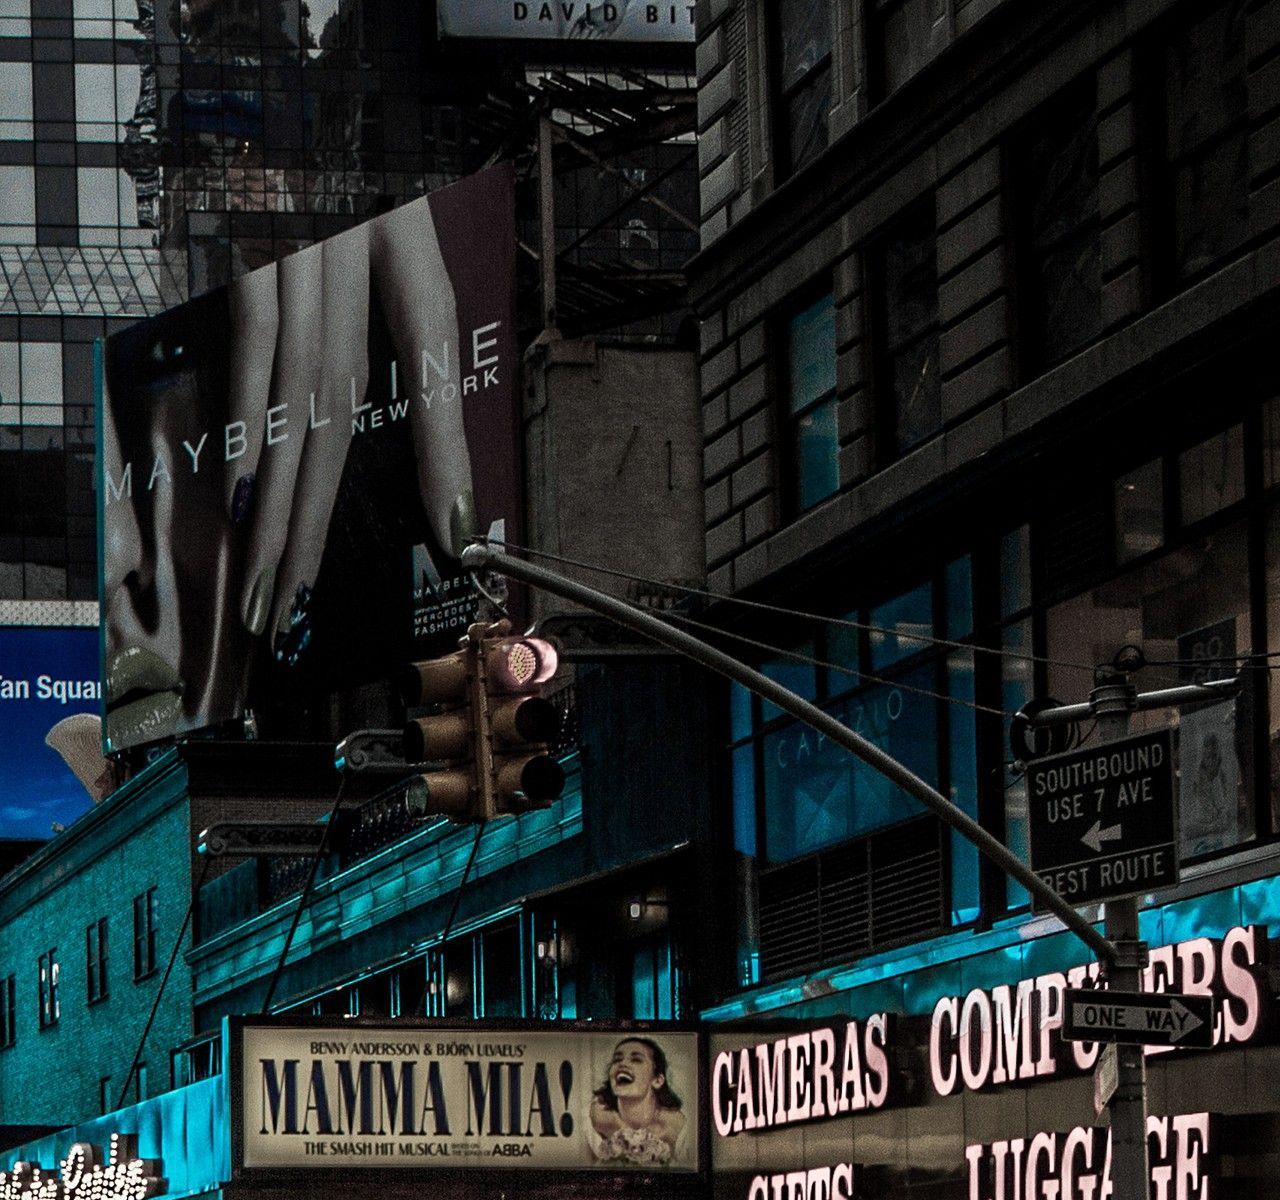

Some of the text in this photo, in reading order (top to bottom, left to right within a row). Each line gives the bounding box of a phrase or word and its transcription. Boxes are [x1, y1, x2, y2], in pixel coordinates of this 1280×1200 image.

[514, 2, 617, 22] DAVID
[105, 320, 501, 508] MAYBELLINE
[352, 366, 500, 436] NEW YORK
[1035, 743, 1163, 796] SOUTHBOUND
[1046, 777, 1154, 823] USE 7 AVE
[1099, 851, 1165, 888] ROUTE
[712, 925, 1261, 1138] CAMERAS COMPUERS
[1084, 1006, 1190, 1032] ONE WAY
[310, 1041, 347, 1055] BENNY
[351, 1042, 419, 1056] ANDERSSON
[424, 1043, 433, 1056] &
[436, 1040, 474, 1056] BJÖRN
[259, 1059, 574, 1138] MAMMA MIA!
[304, 1141, 327, 1155] THE
[330, 1142, 372, 1156] SMASH
[375, 1143, 395, 1156] HIT
[398, 1143, 450, 1156] MUSICAL
[492, 1144, 531, 1157] ABBA
